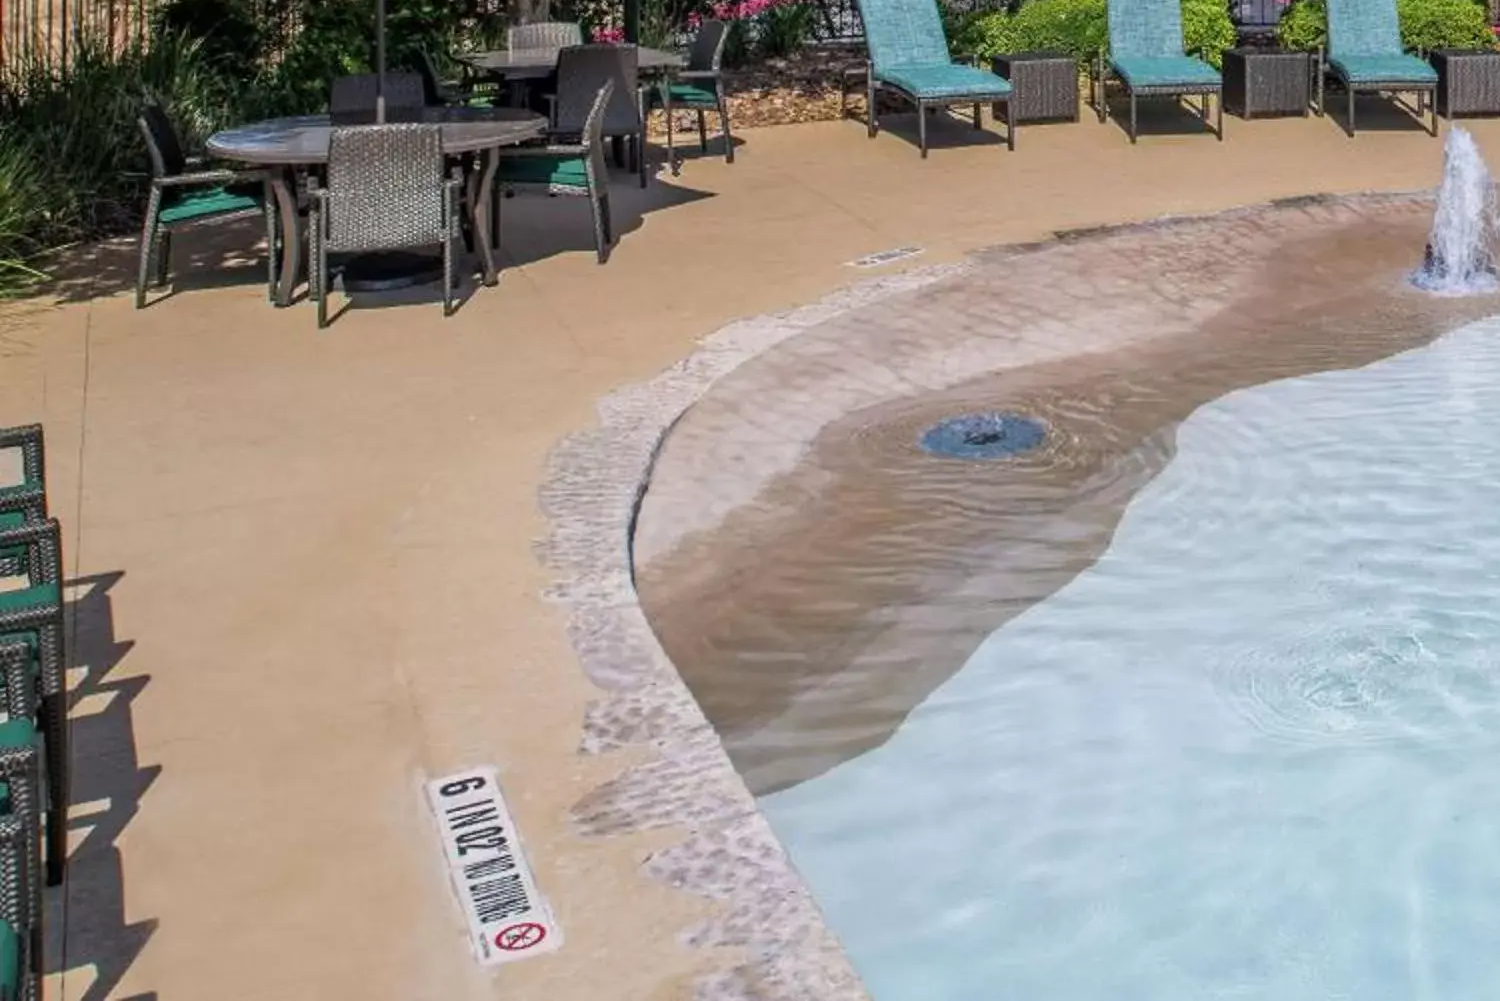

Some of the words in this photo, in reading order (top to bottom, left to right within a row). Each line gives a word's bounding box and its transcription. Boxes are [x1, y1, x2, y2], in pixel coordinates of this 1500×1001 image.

[439, 776, 486, 796] 6
[445, 798, 499, 830] IN
[463, 854, 516, 880] NO
[469, 873, 531, 924] DIVING
